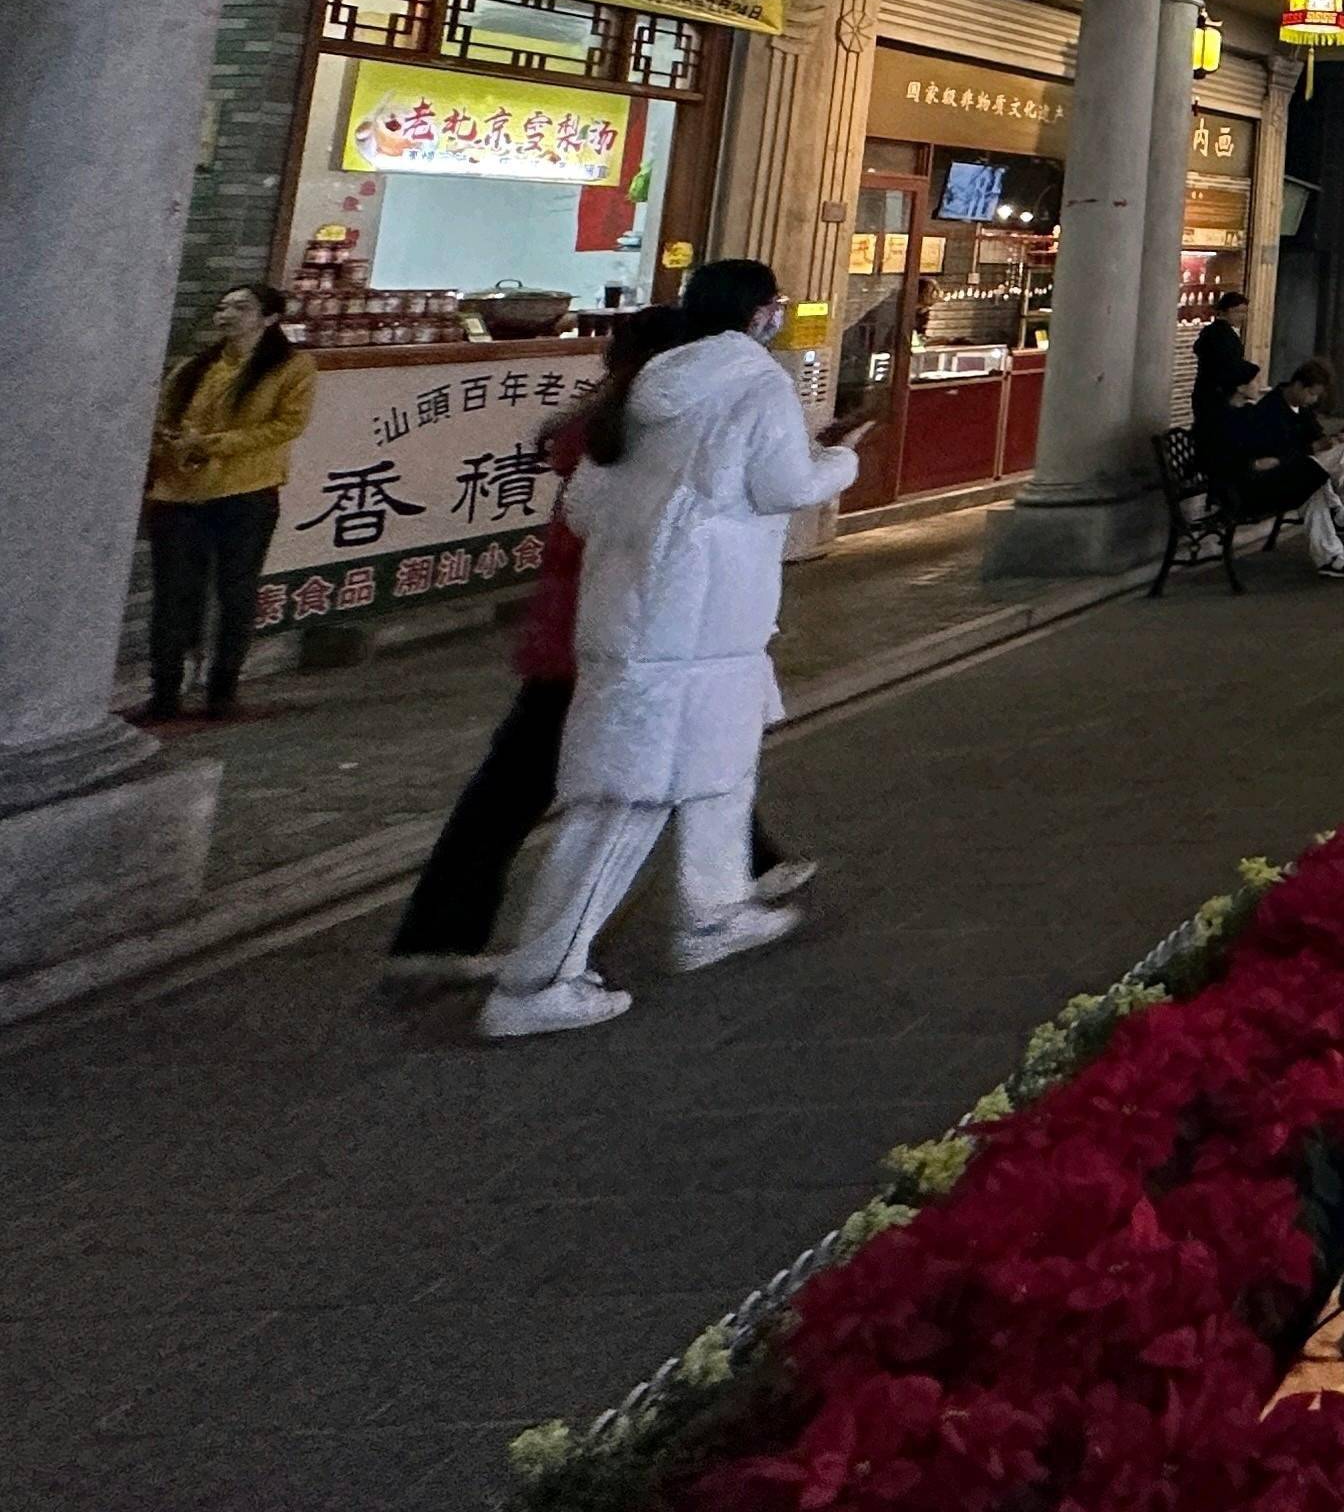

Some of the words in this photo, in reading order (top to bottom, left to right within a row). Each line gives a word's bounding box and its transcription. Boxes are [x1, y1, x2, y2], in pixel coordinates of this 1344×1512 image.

[402, 96, 619, 155] 老北京雪梨汤
